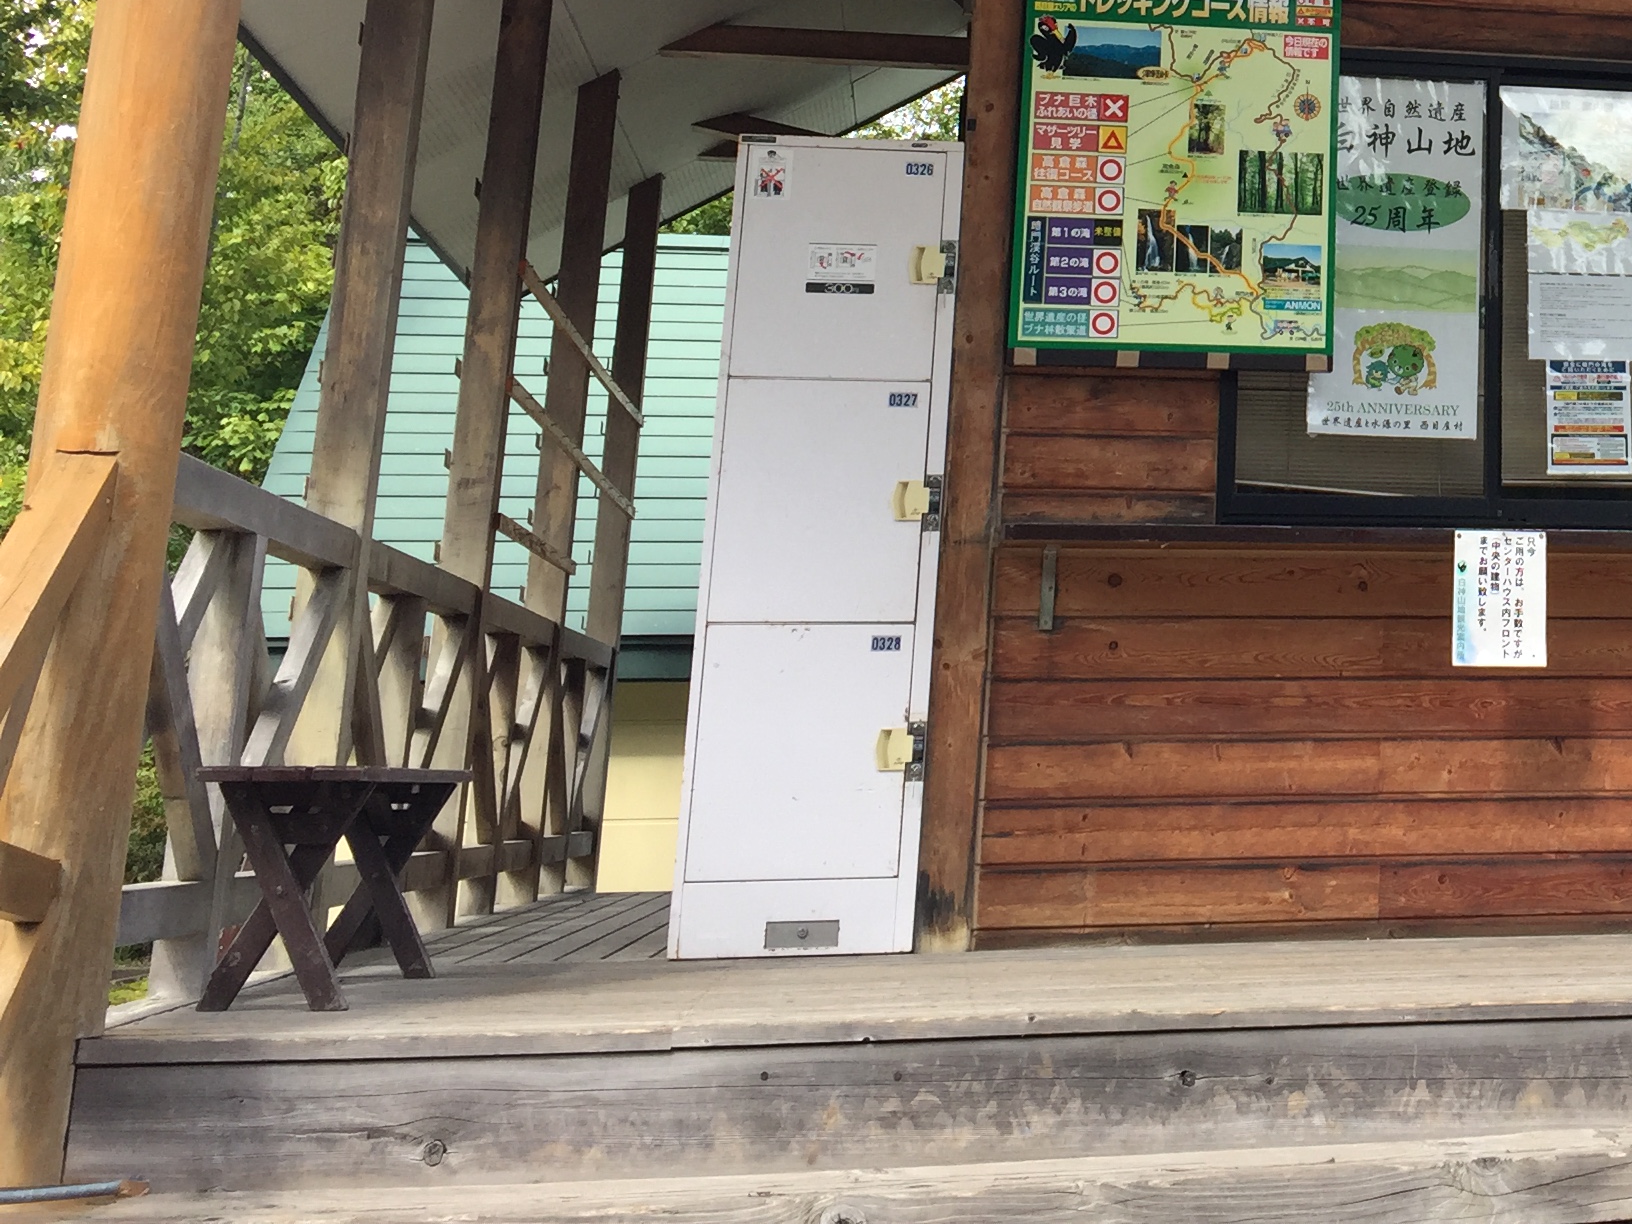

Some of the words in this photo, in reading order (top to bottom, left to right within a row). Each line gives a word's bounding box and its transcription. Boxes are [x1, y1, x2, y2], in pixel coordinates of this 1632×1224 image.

[1285, 36, 1328, 48] 今日現在の
[1039, 94, 1097, 106] ブナ巨木
[1338, 96, 1467, 122] 世界自然遺産
[1036, 125, 1097, 137] マザーツリー
[1050, 137, 1082, 150] 見学
[905, 163, 934, 176] 0326
[1284, 301, 1321, 310] ANMON
[888, 393, 918, 407] 0327
[1327, 401, 1354, 413] 25th
[1356, 402, 1460, 417] ANNIVERSARY
[1527, 537, 1536, 557] 只今
[1477, 536, 1488, 632] までお願い致します。
[1501, 537, 1512, 659] センターハウス内フロント
[871, 637, 901, 651] 0328
